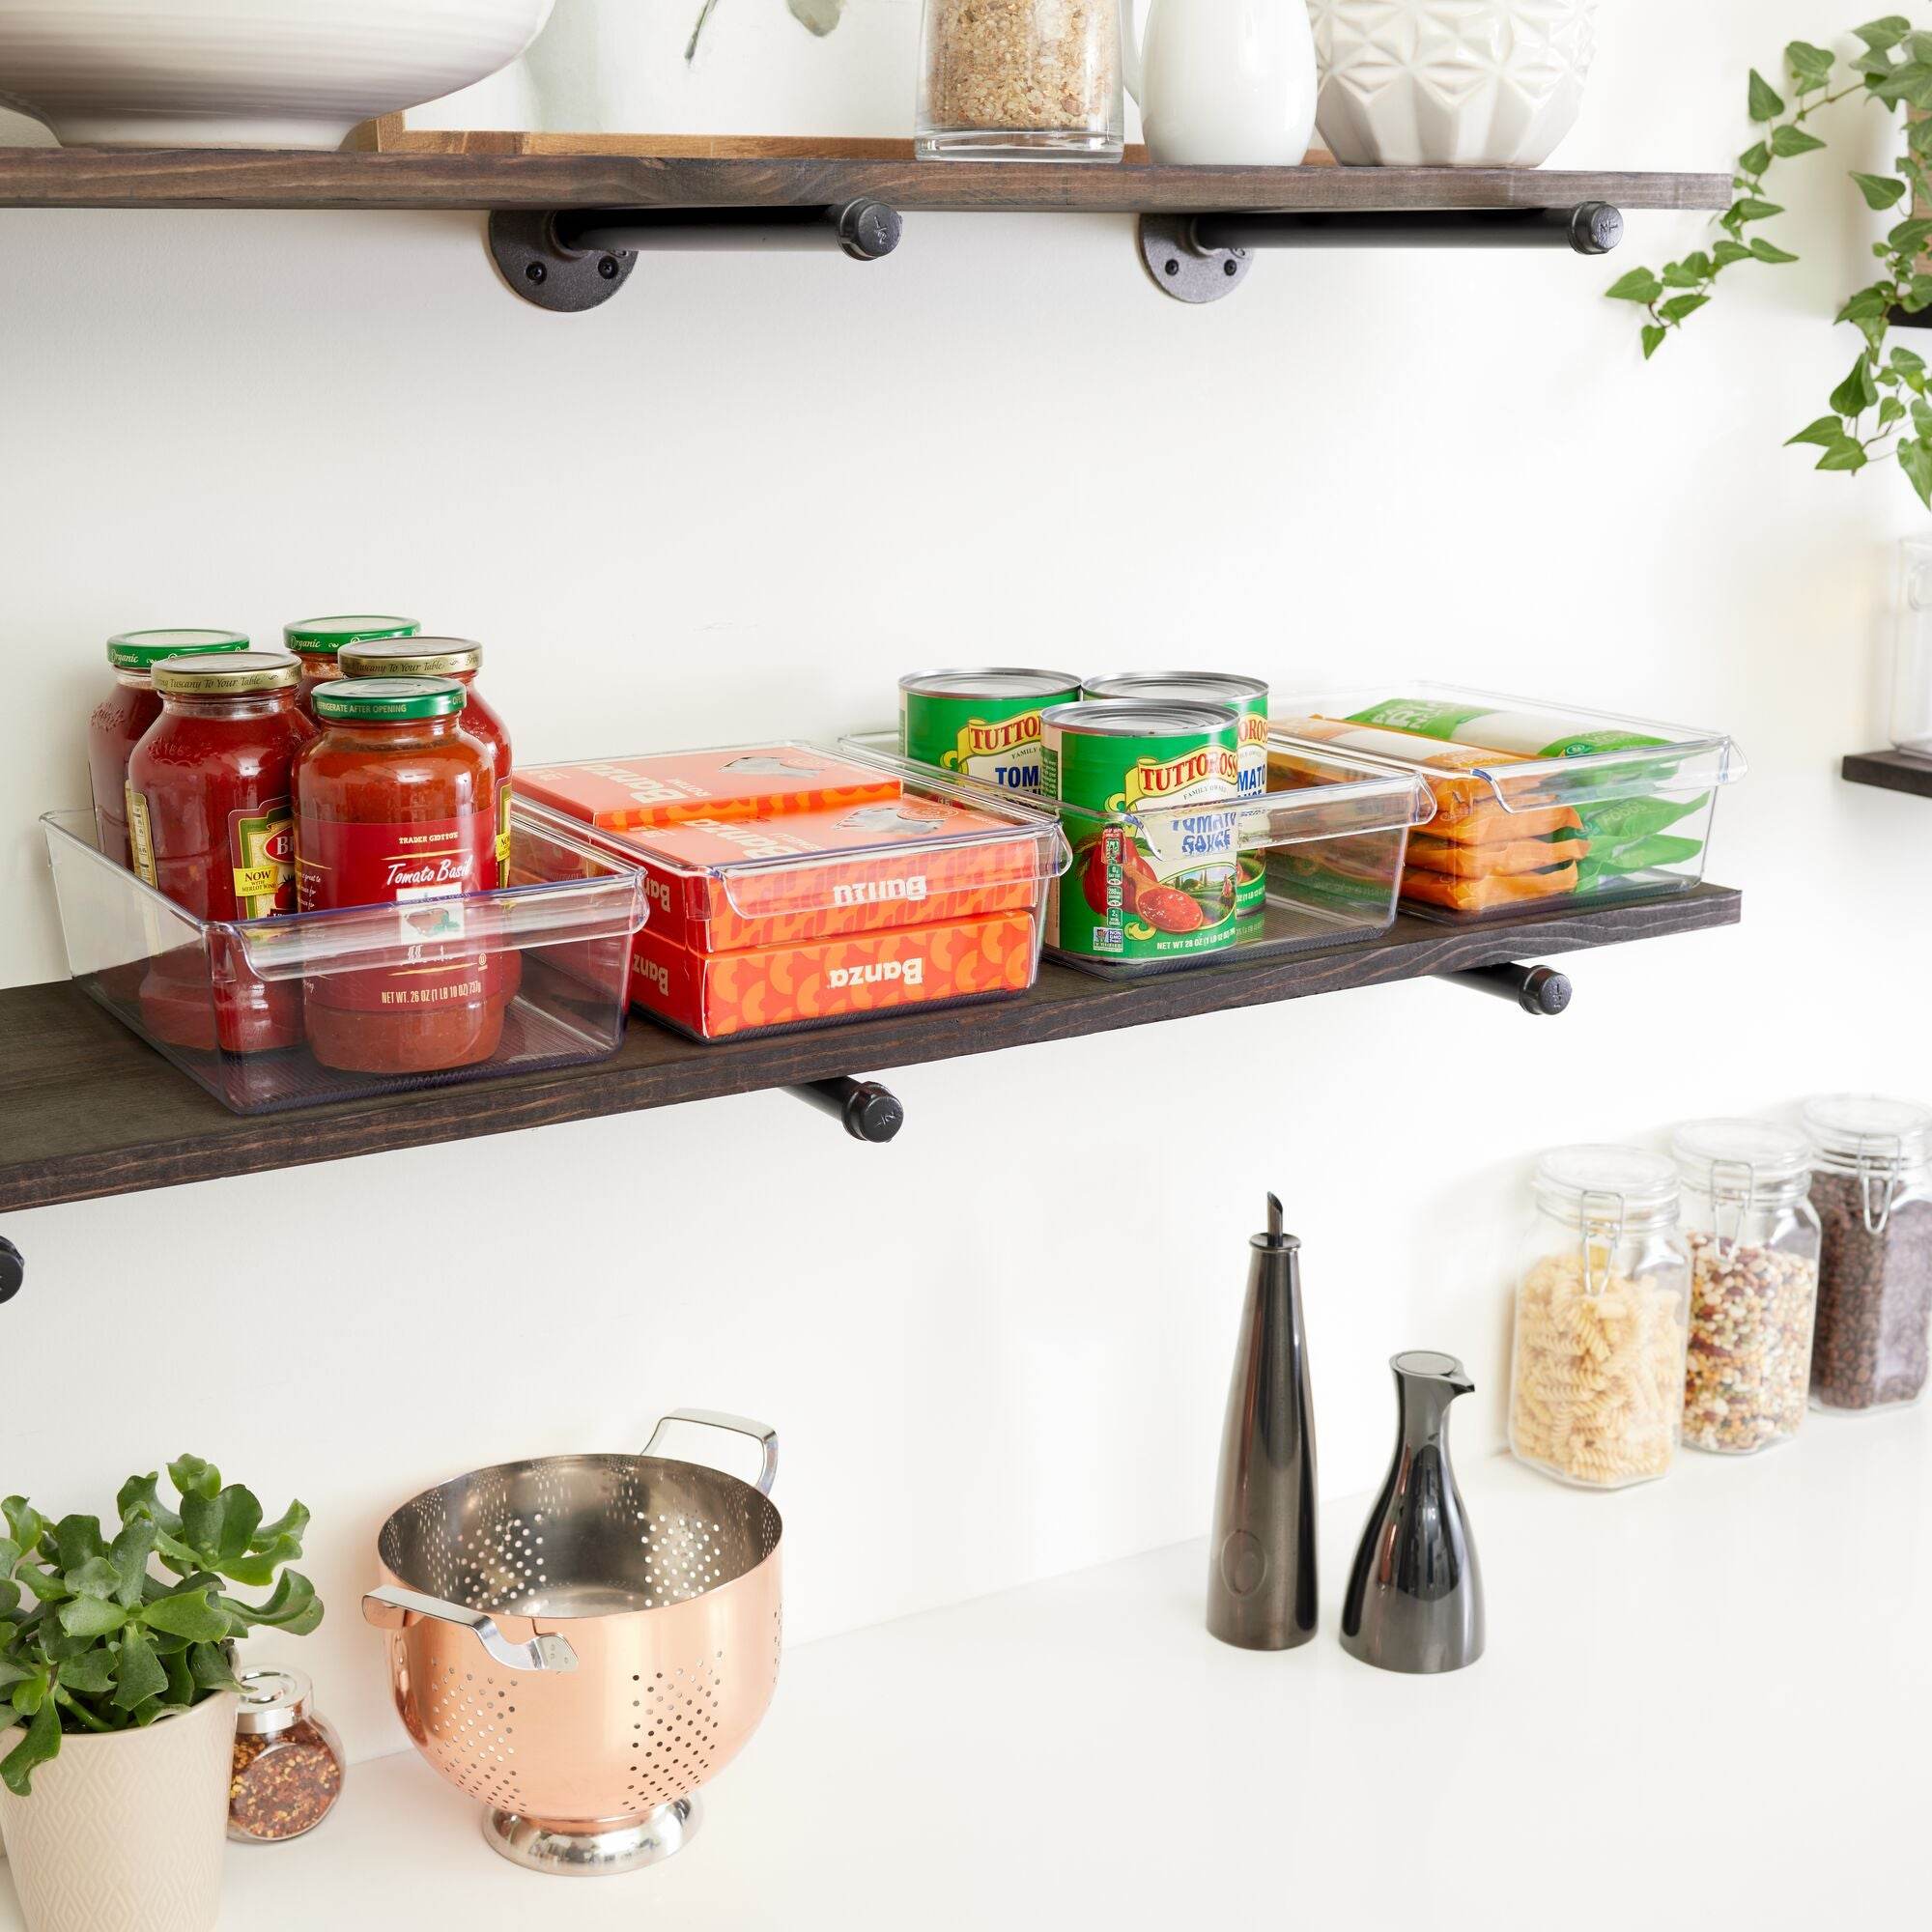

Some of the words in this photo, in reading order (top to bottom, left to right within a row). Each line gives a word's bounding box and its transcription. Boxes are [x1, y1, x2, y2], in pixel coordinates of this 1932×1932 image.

[291, 635, 321, 650] Organic
[109, 648, 139, 665] Organic
[401, 663, 421, 671] Your
[424, 661, 442, 671] Table
[216, 678, 238, 688] Your
[349, 703, 371, 713] AFTER
[374, 702, 407, 713] OPENING
[970, 715, 1040, 751] TUTTO
[994, 765, 1040, 788] TOM
[1183, 785, 1208, 801] FAMILY
[399, 836, 427, 844] TRADER
[244, 870, 271, 882] NOW
[386, 863, 435, 886] Tomato
[437, 854, 473, 882] Basil
[828, 957, 923, 989] Banza
[382, 991, 395, 1004] NET
[395, 991, 410, 1004] WT.
[411, 990, 420, 1003] 26
[421, 989, 431, 1002] OZ
[440, 986, 448, 1000] LB
